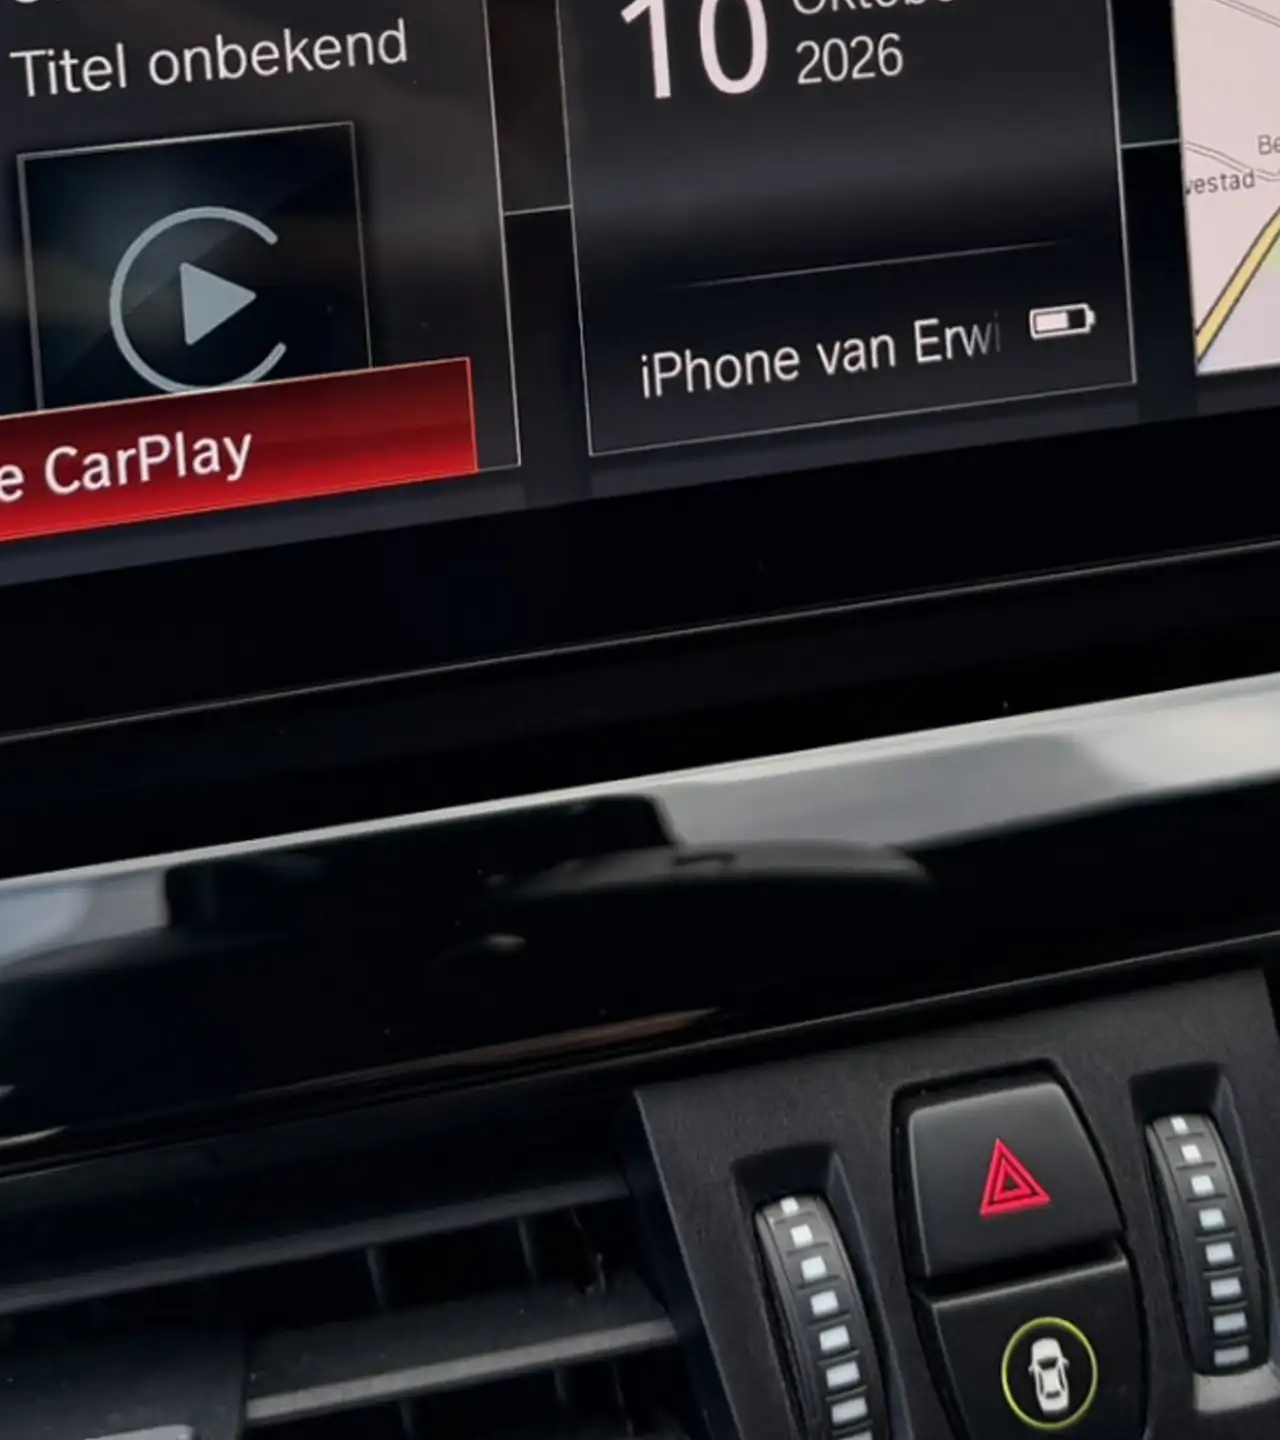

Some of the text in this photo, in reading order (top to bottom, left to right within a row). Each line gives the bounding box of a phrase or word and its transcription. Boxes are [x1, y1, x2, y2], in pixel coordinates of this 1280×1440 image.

[9, 18, 409, 98] Titel onbekend
[795, 32, 904, 85] 2026
[640, 345, 801, 399] iPhone
[816, 332, 897, 376] van
[42, 428, 254, 496] CarPlay
